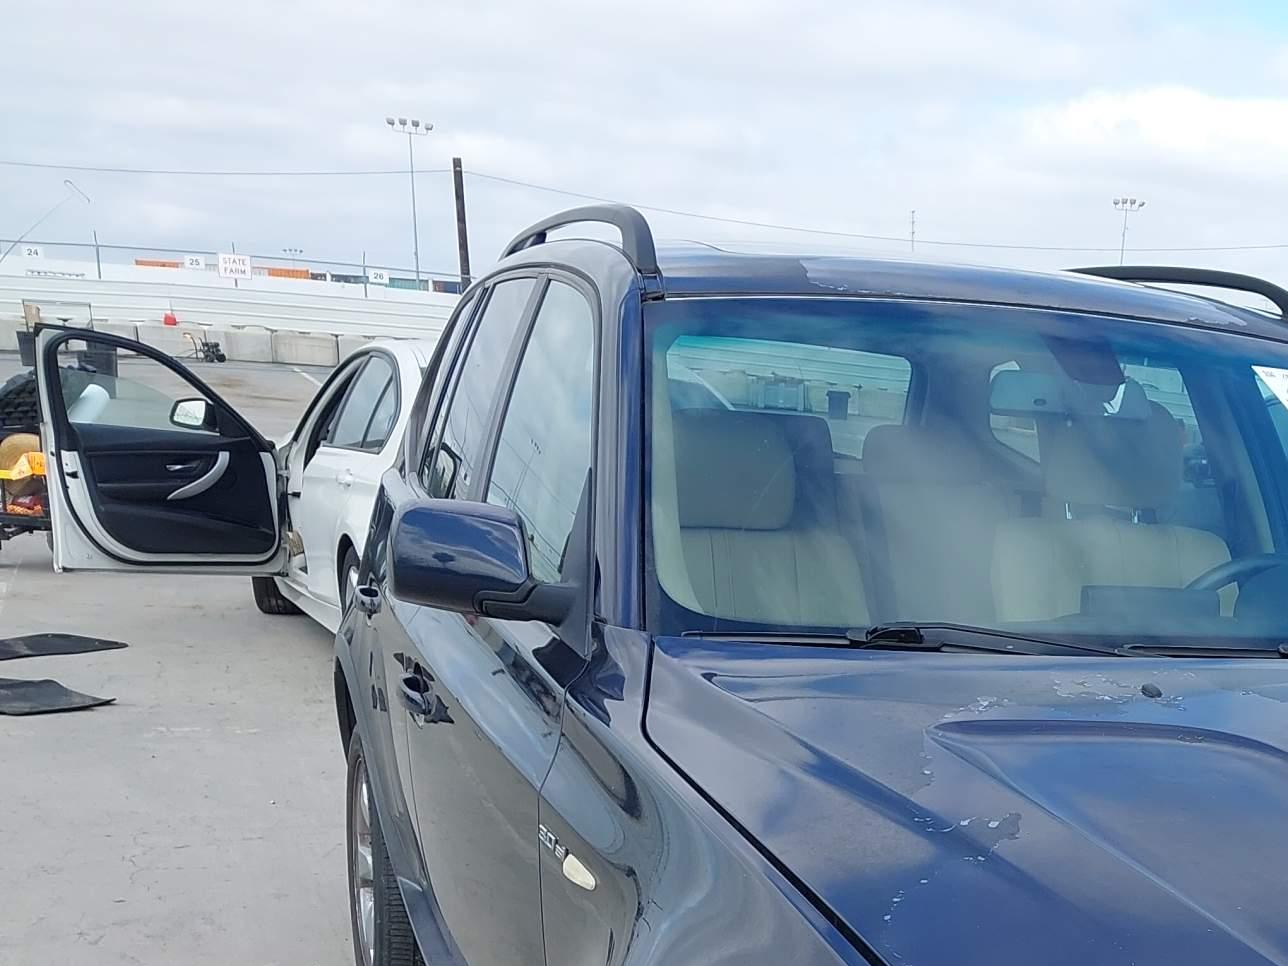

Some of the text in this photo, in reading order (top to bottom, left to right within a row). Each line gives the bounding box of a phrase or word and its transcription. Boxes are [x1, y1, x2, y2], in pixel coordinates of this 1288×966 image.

[26, 248, 39, 256] 24
[189, 258, 201, 266] 25
[222, 257, 247, 266] STATE
[224, 266, 247, 275] FARM
[373, 272, 384, 280] 26
